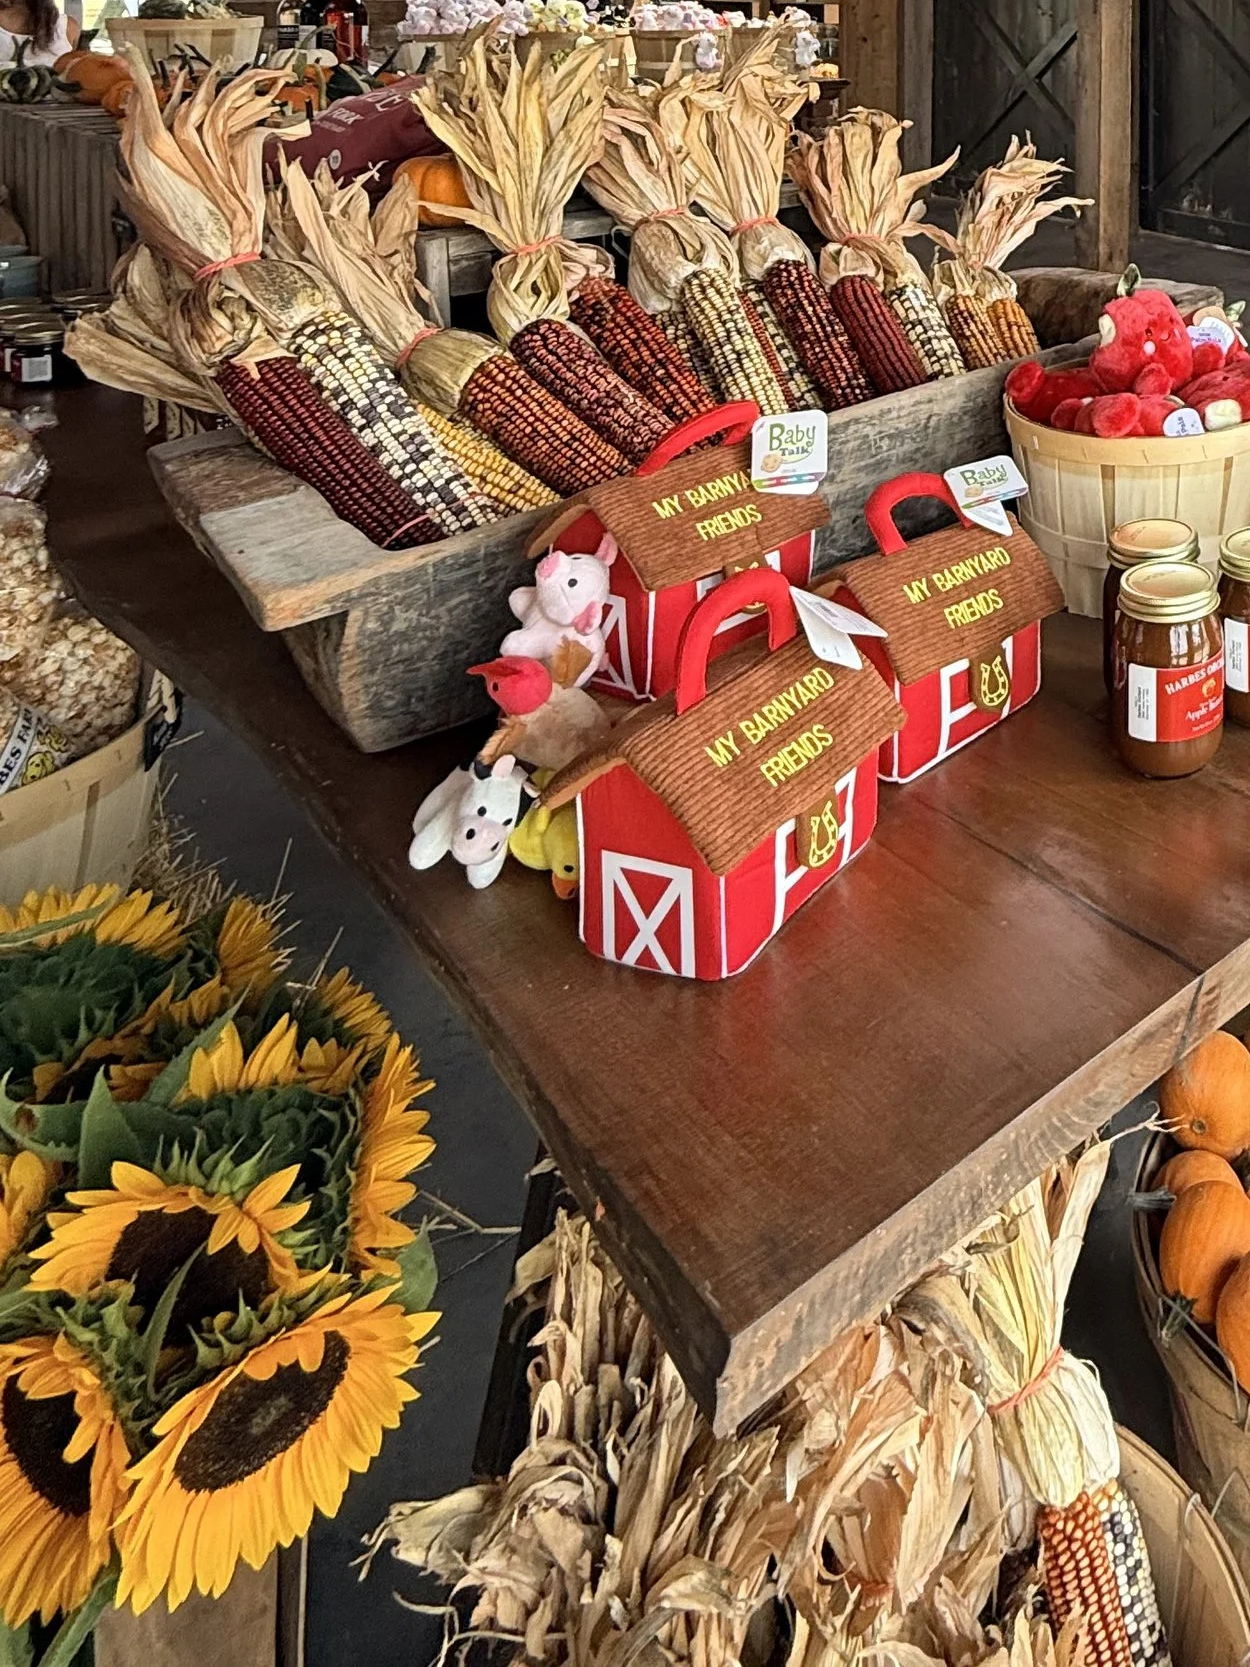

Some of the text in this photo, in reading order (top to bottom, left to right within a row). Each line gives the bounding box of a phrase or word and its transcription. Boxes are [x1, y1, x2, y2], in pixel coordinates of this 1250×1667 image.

[769, 422, 816, 451] Baby
[780, 445, 812, 456] Talk
[959, 463, 1008, 486] Baby
[652, 471, 751, 520] MY BARNYA
[695, 503, 762, 541] FRIENDS
[902, 547, 1011, 604] MY BARNYARD
[943, 588, 1004, 629] FRIENDS
[1165, 669, 1206, 695] HARBES
[704, 667, 835, 768] MY BARNYARD
[1185, 705, 1208, 721] Apple
[760, 724, 834, 787] FRIENDS
